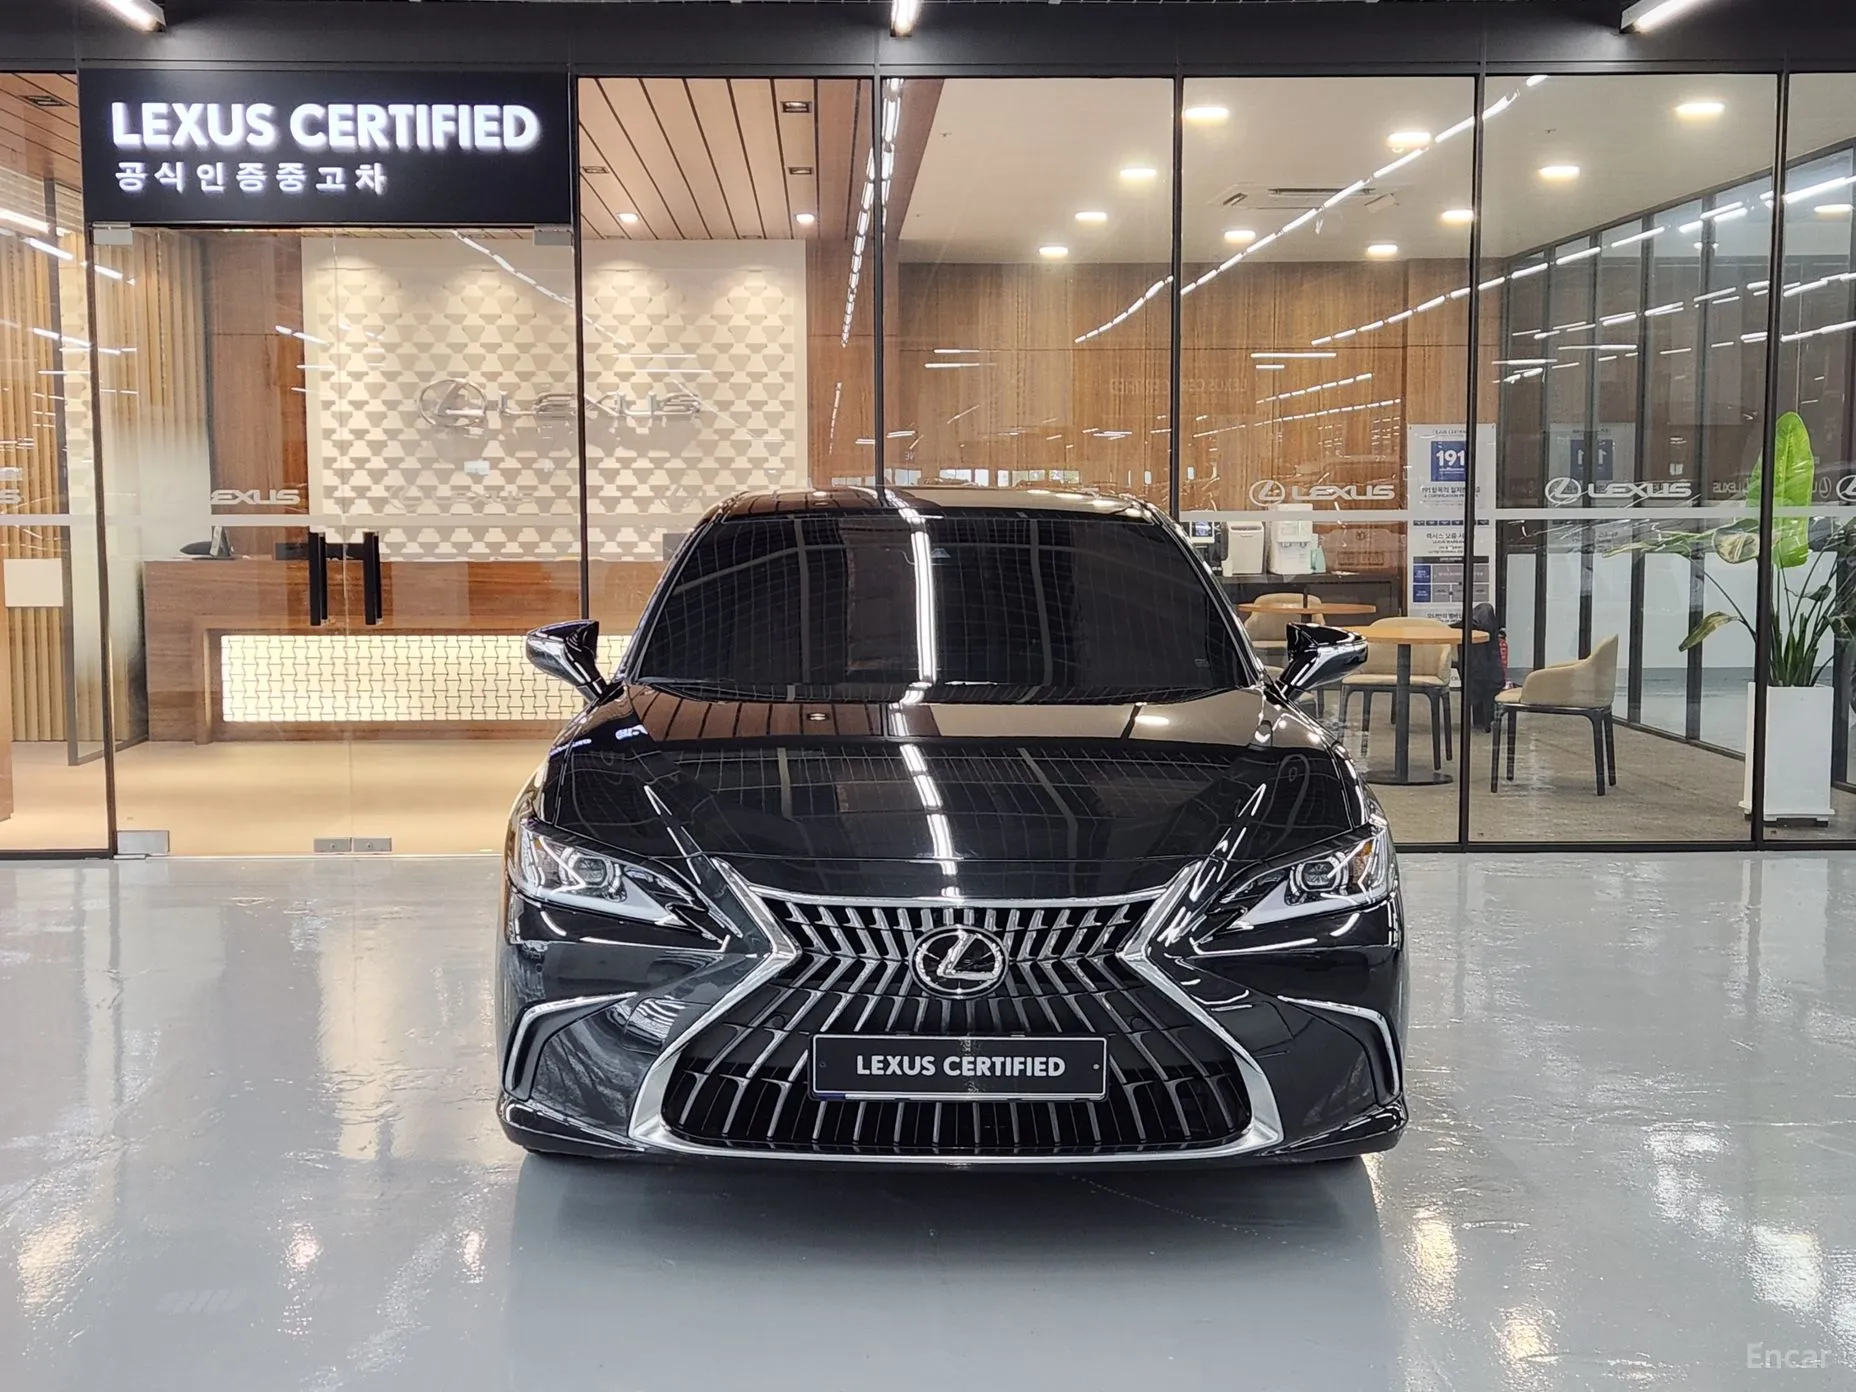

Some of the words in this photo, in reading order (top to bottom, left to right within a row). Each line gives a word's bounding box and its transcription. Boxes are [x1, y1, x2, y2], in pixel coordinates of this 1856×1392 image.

[111, 102, 276, 150] LEXUS
[290, 104, 540, 151] CERTIFIED
[115, 161, 388, 194] 공식인증중고차
[1436, 450, 1465, 466] 191
[210, 489, 300, 506] EXUS
[1292, 485, 1396, 500] LEXUS
[1588, 482, 1692, 498] LEXUS
[857, 1055, 936, 1076] LEXUS
[943, 1056, 1066, 1077] CERTIFIED
